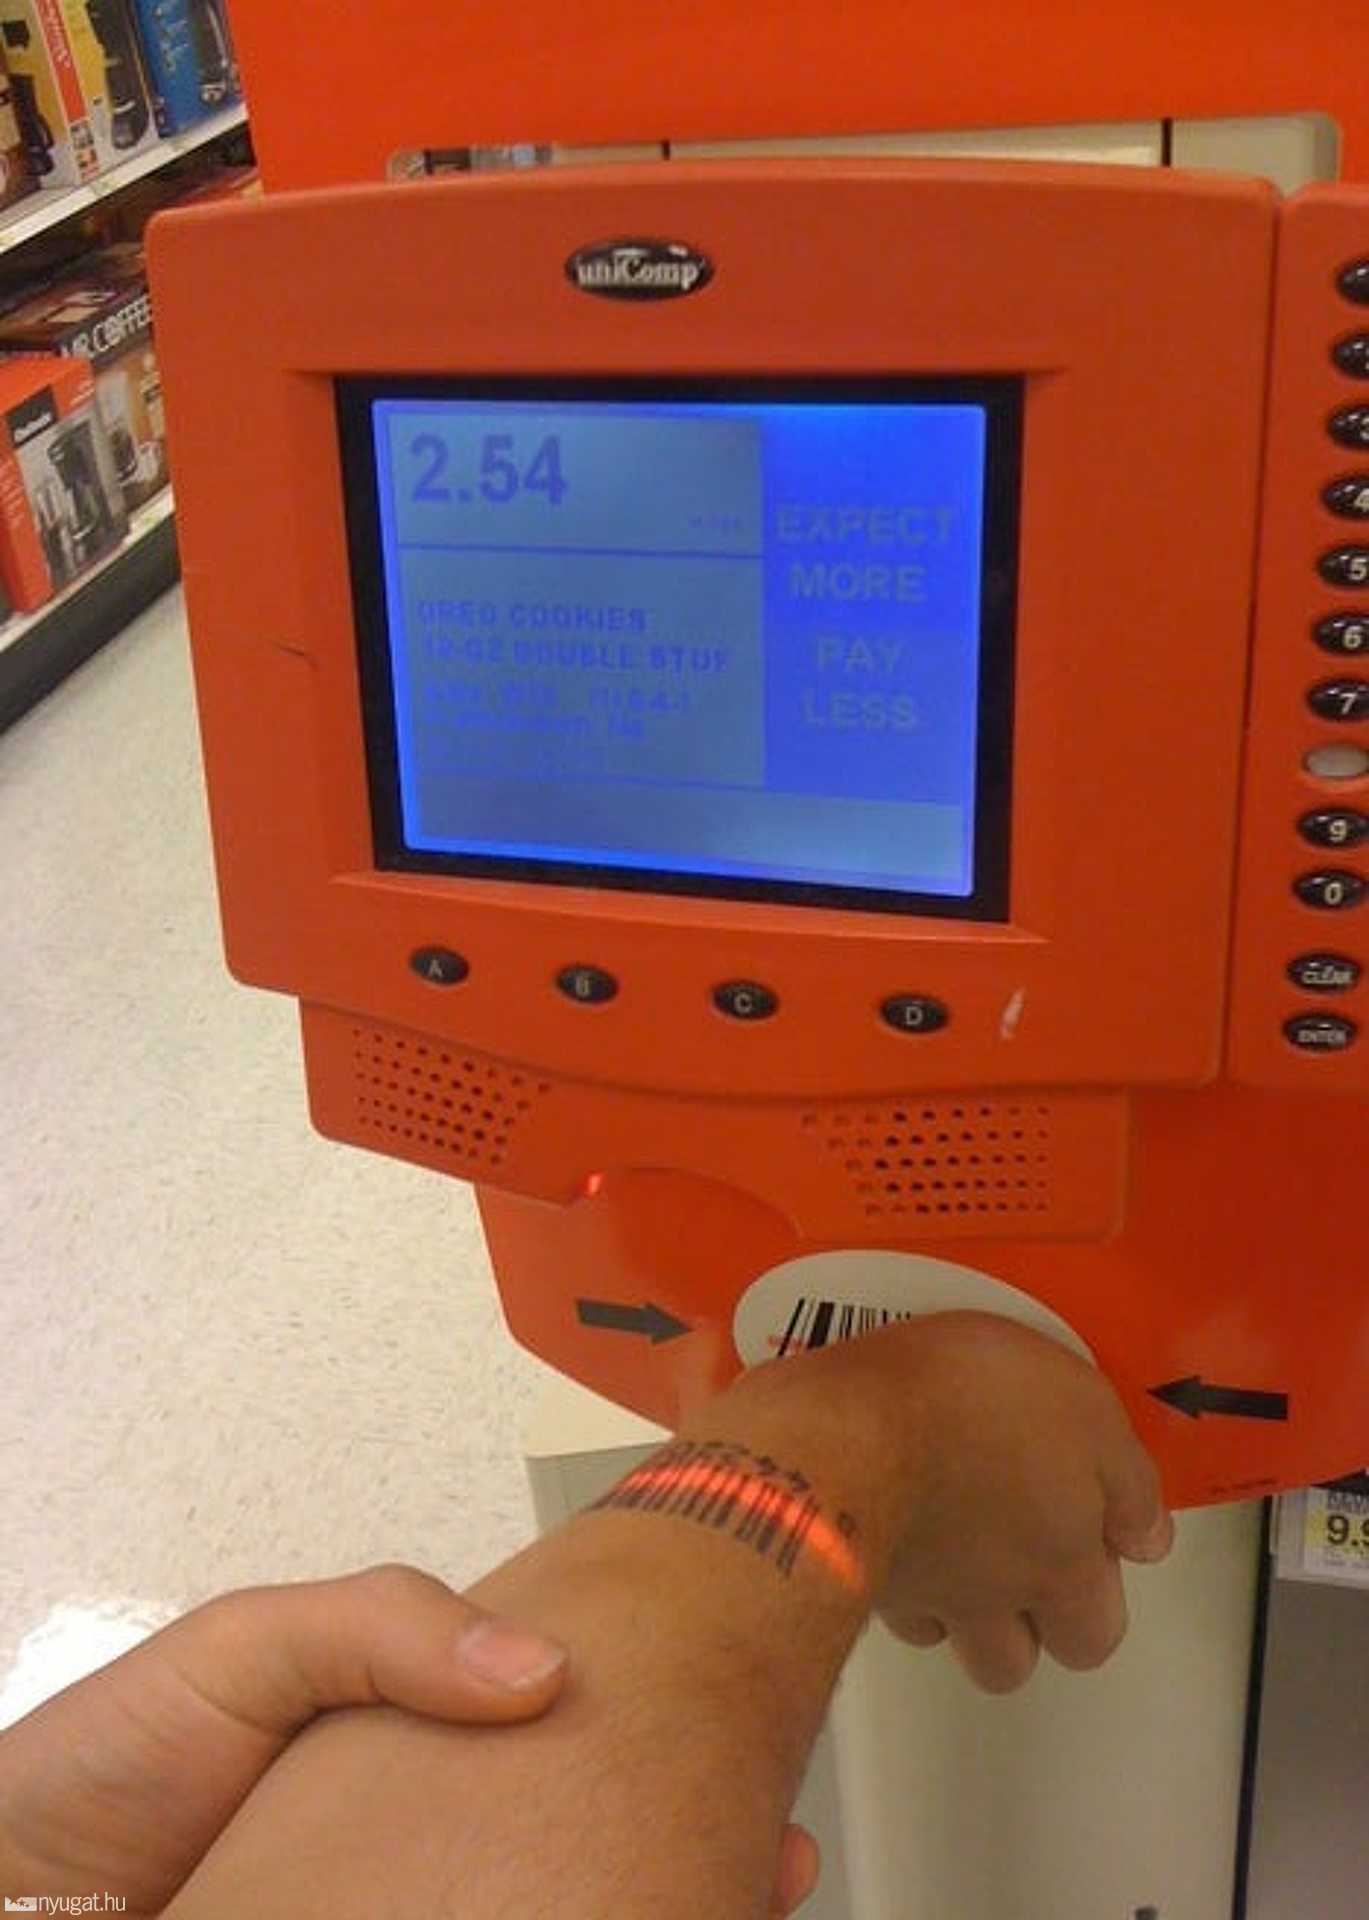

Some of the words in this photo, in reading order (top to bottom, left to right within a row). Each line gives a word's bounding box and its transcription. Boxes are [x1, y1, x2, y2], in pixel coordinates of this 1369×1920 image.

[409, 432, 567, 505] 2.54
[776, 504, 956, 545] EXPECT
[790, 562, 928, 603] MORE
[1348, 556, 1367, 581] 5
[417, 599, 497, 628] OREO
[509, 602, 648, 632] COOKIES
[1343, 625, 1362, 650] 6
[513, 638, 634, 671] DOUBLE
[816, 635, 905, 673] PAY
[803, 688, 919, 731] LESS
[1339, 692, 1357, 716] 7
[1328, 819, 1348, 843] 9
[427, 958, 444, 977] A
[734, 993, 752, 1015] C
[905, 1003, 923, 1026] D
